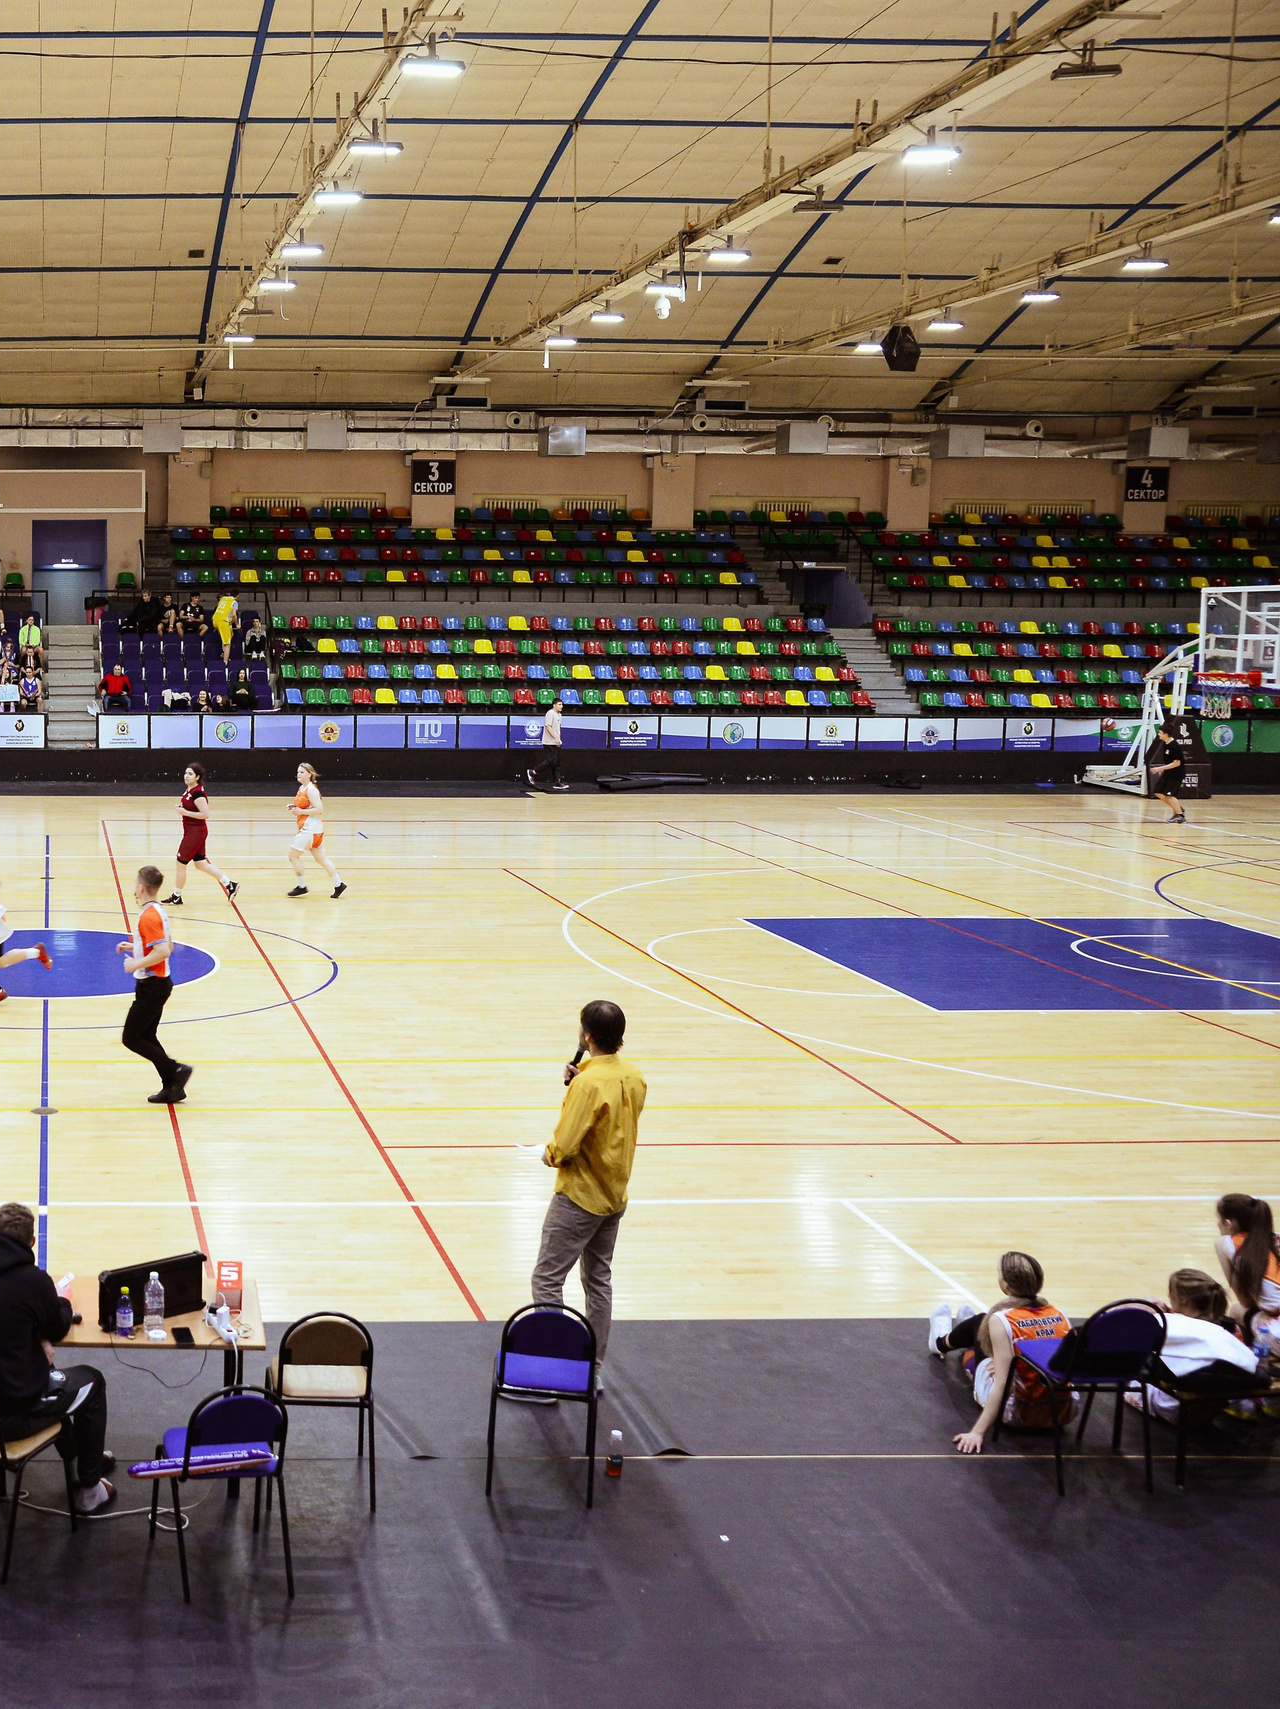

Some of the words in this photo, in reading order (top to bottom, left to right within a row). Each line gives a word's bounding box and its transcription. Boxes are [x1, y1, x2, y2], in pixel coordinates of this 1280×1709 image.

[428, 462, 440, 481] 3
[1141, 469, 1153, 488] 4
[414, 482, 453, 493] СЕКТОР
[1127, 489, 1165, 500] СЕКТОР
[220, 1266, 239, 1281] 5
